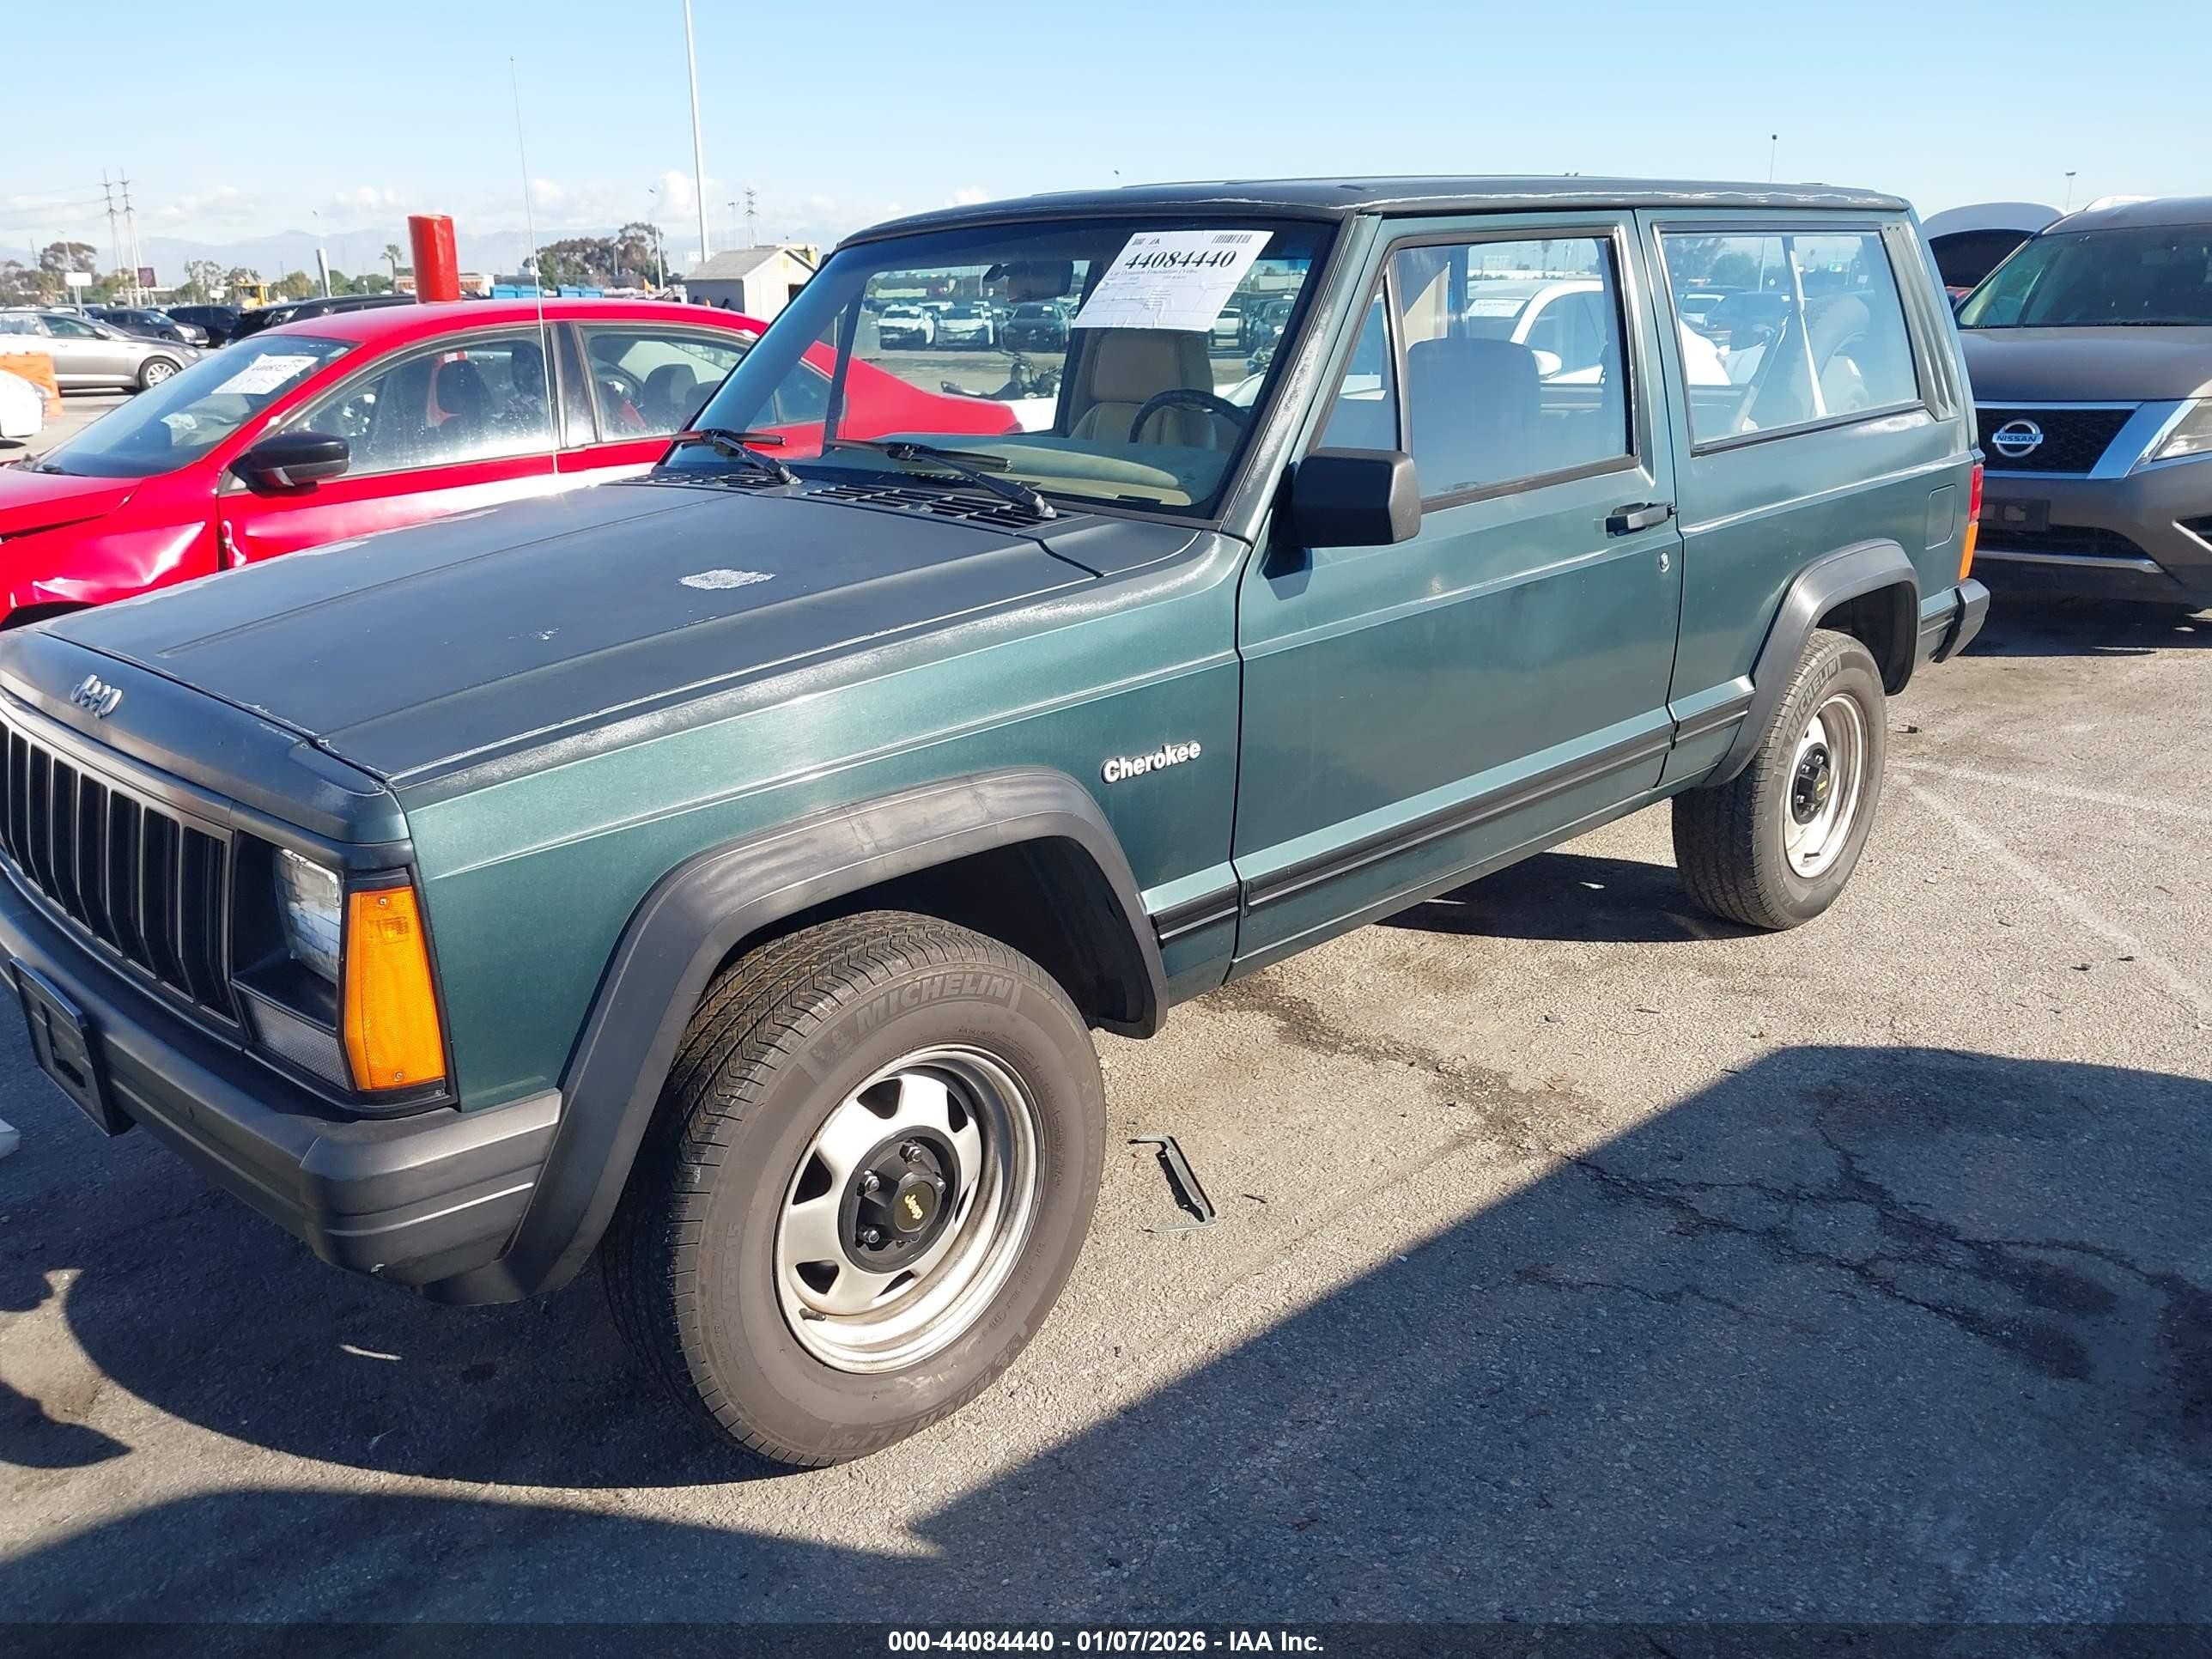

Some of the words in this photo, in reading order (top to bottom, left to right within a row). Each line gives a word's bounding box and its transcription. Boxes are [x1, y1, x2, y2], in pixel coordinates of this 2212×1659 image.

[1125, 250, 1237, 269] 44084440
[70, 674, 123, 720] Jeep
[1786, 658, 1838, 743] MICHELIN
[1100, 740, 1202, 785] Cherokee
[858, 973, 1014, 1030] MICHELIN
[904, 1194, 923, 1220] Jeep
